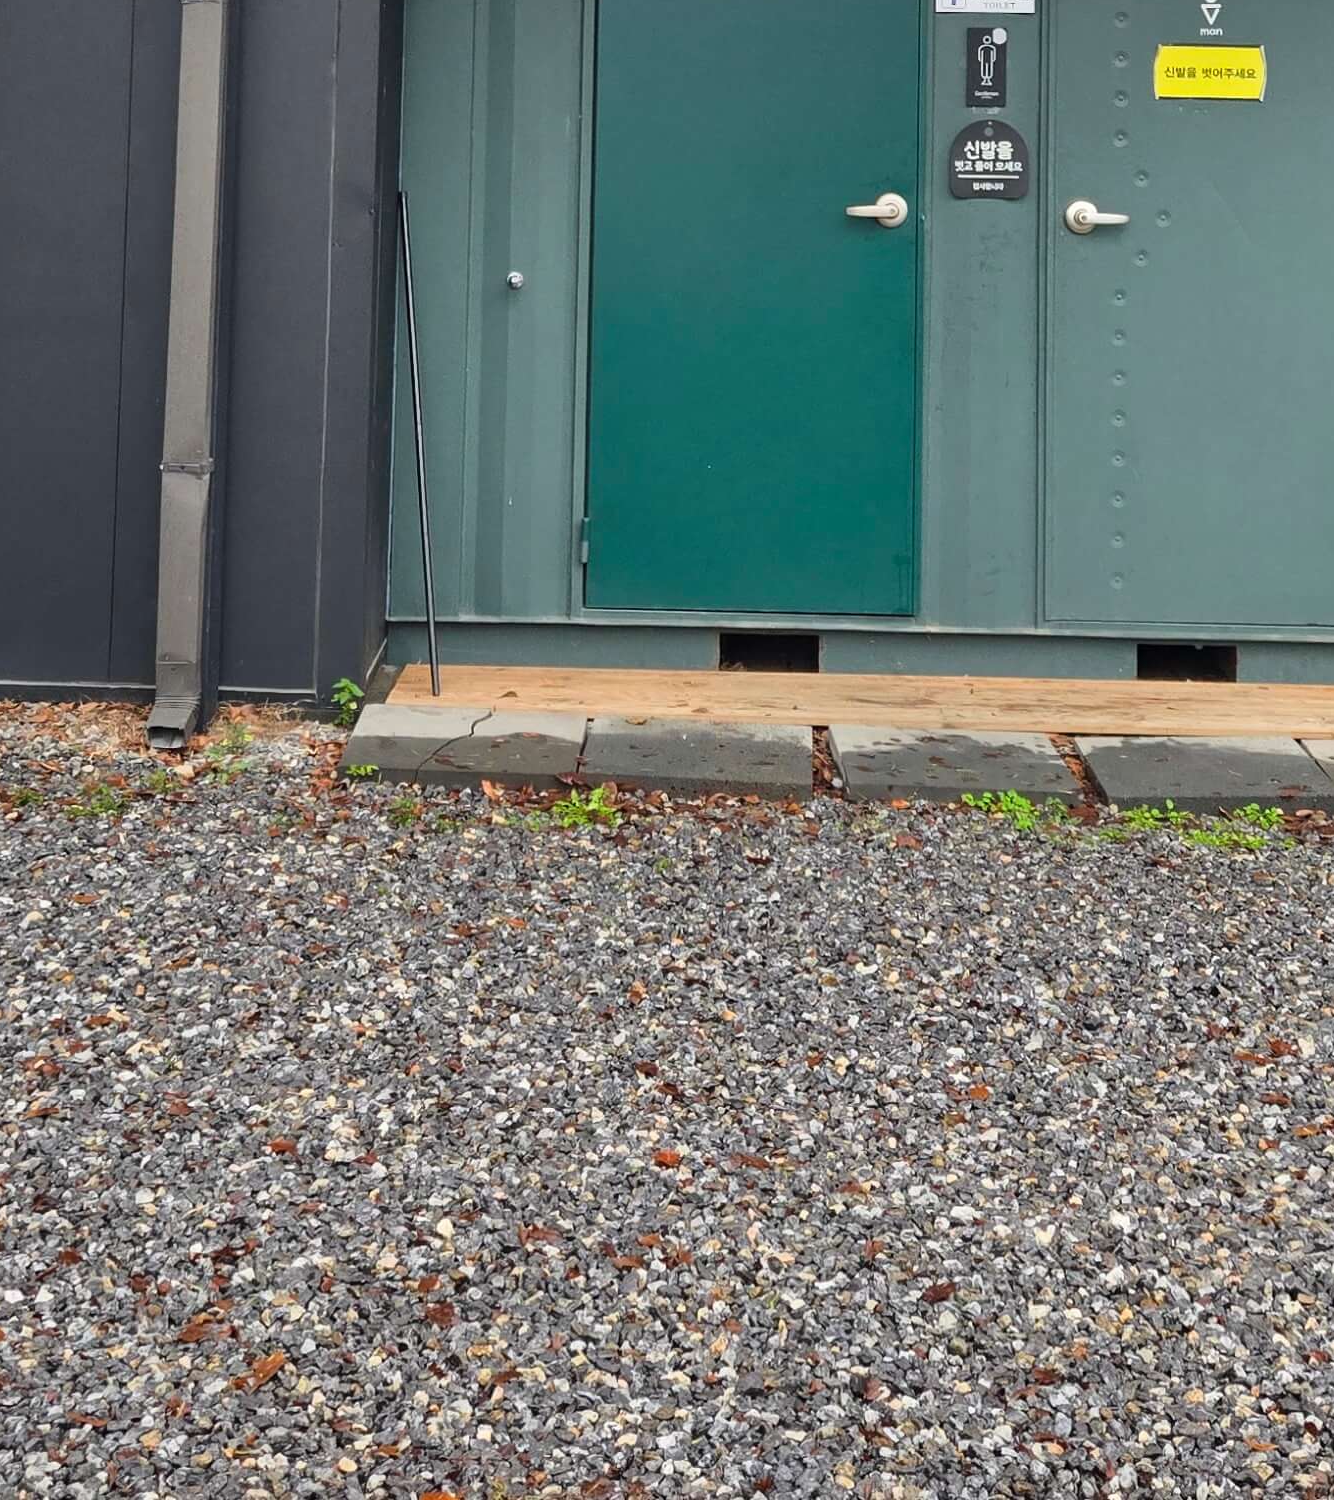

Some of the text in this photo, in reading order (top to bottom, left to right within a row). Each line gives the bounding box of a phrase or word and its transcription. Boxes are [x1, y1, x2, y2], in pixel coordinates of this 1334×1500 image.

[983, 2, 1016, 10] TOILET
[1199, 28, 1223, 36] man
[1164, 67, 1257, 79] 신발을 벗어주세요
[964, 140, 1014, 160] 신발을
